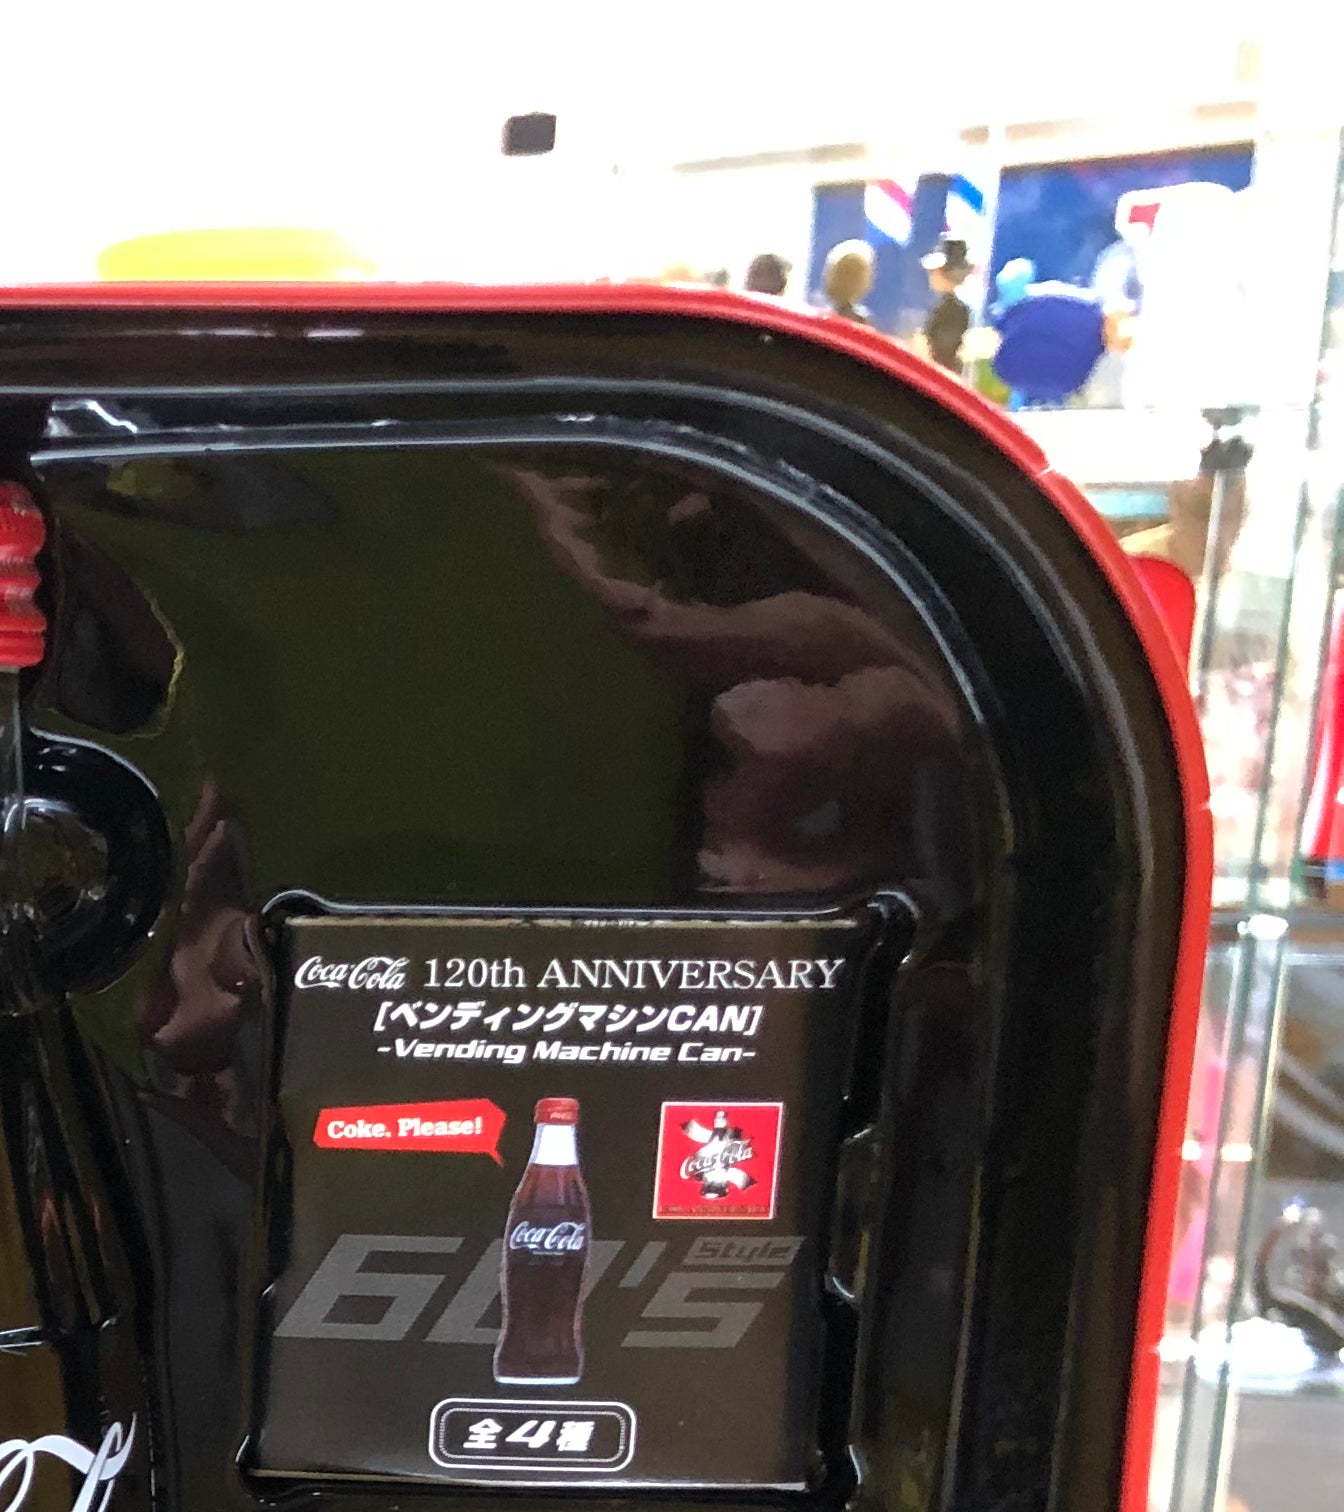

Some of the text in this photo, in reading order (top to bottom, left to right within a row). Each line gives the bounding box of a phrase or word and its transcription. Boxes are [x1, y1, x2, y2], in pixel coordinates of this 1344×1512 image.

[294, 956, 846, 991] Coca-Cola 120th ANNIVERSARY
[533, 1040, 671, 1063] Machine
[327, 1115, 483, 1139] Coke. Please!
[510, 1221, 586, 1250] Coca-Cola
[695, 1242, 791, 1263] Style
[463, 1418, 597, 1452] 全4種
